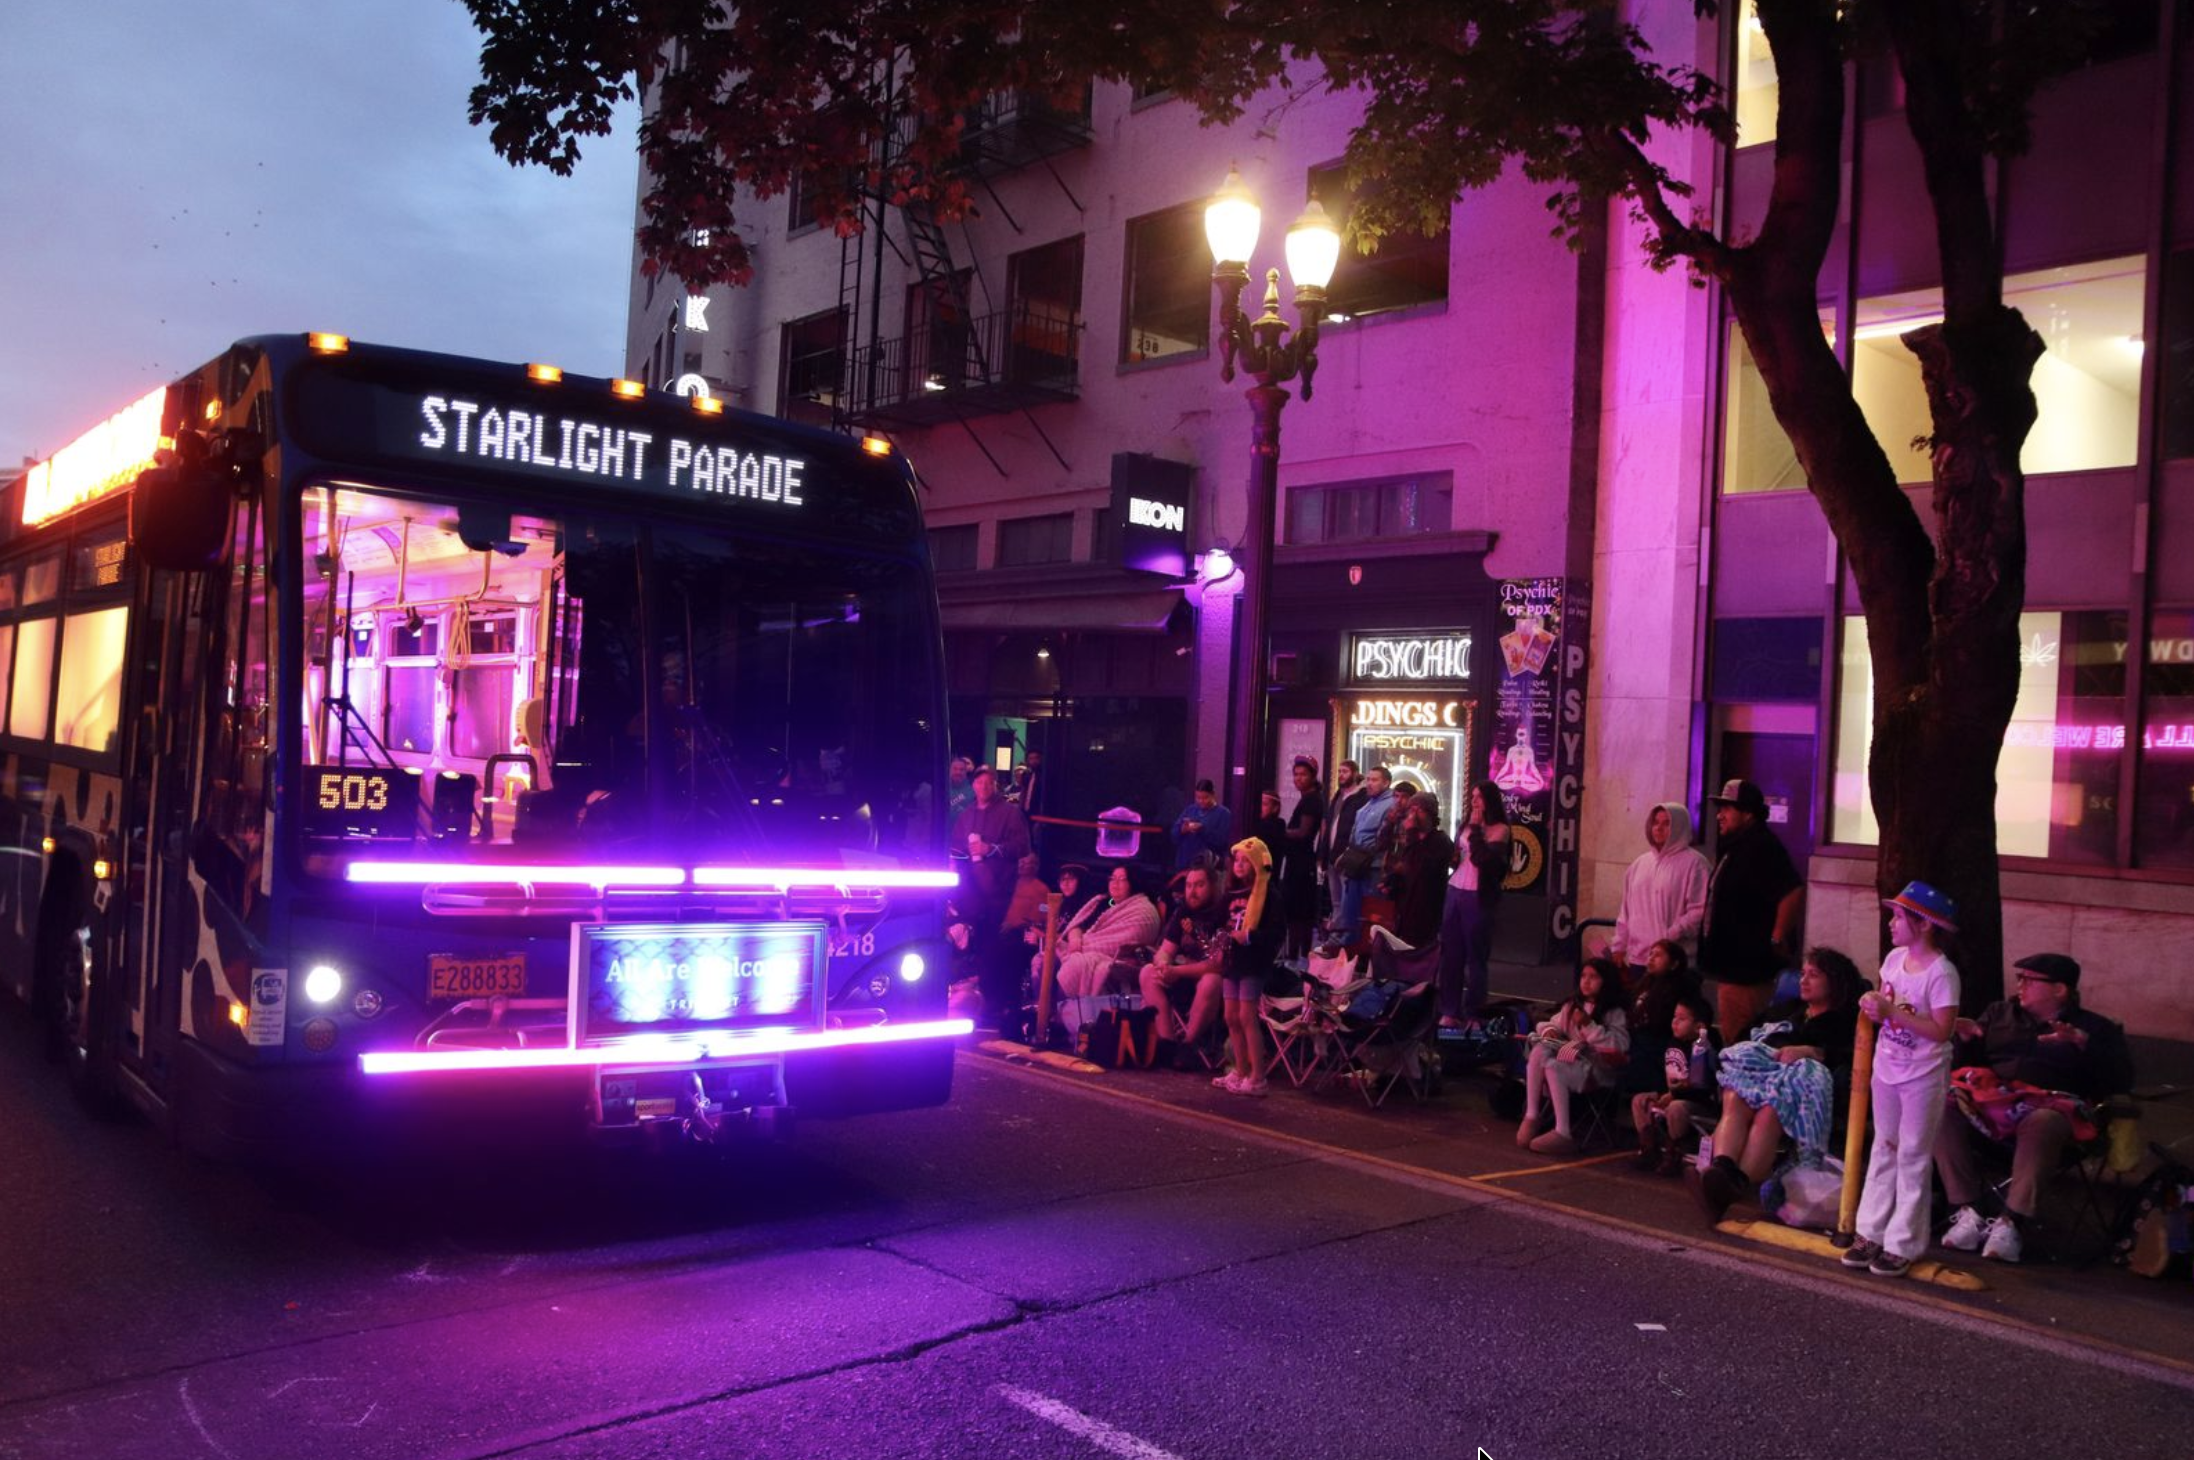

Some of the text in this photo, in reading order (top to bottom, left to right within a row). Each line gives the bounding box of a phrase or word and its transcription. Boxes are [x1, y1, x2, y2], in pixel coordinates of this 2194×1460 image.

[420, 396, 805, 506] STARLIGHT PARADE
[1129, 496, 1185, 532] IKON
[1527, 604, 1553, 616] PDX
[1356, 637, 1472, 679] PSYCHIC
[1351, 700, 1438, 727] DINGS
[1362, 734, 1446, 751] PSYCHIC
[319, 774, 388, 810] 503
[1552, 644, 1585, 940] PSYCHIC
[433, 964, 523, 993] E288833
